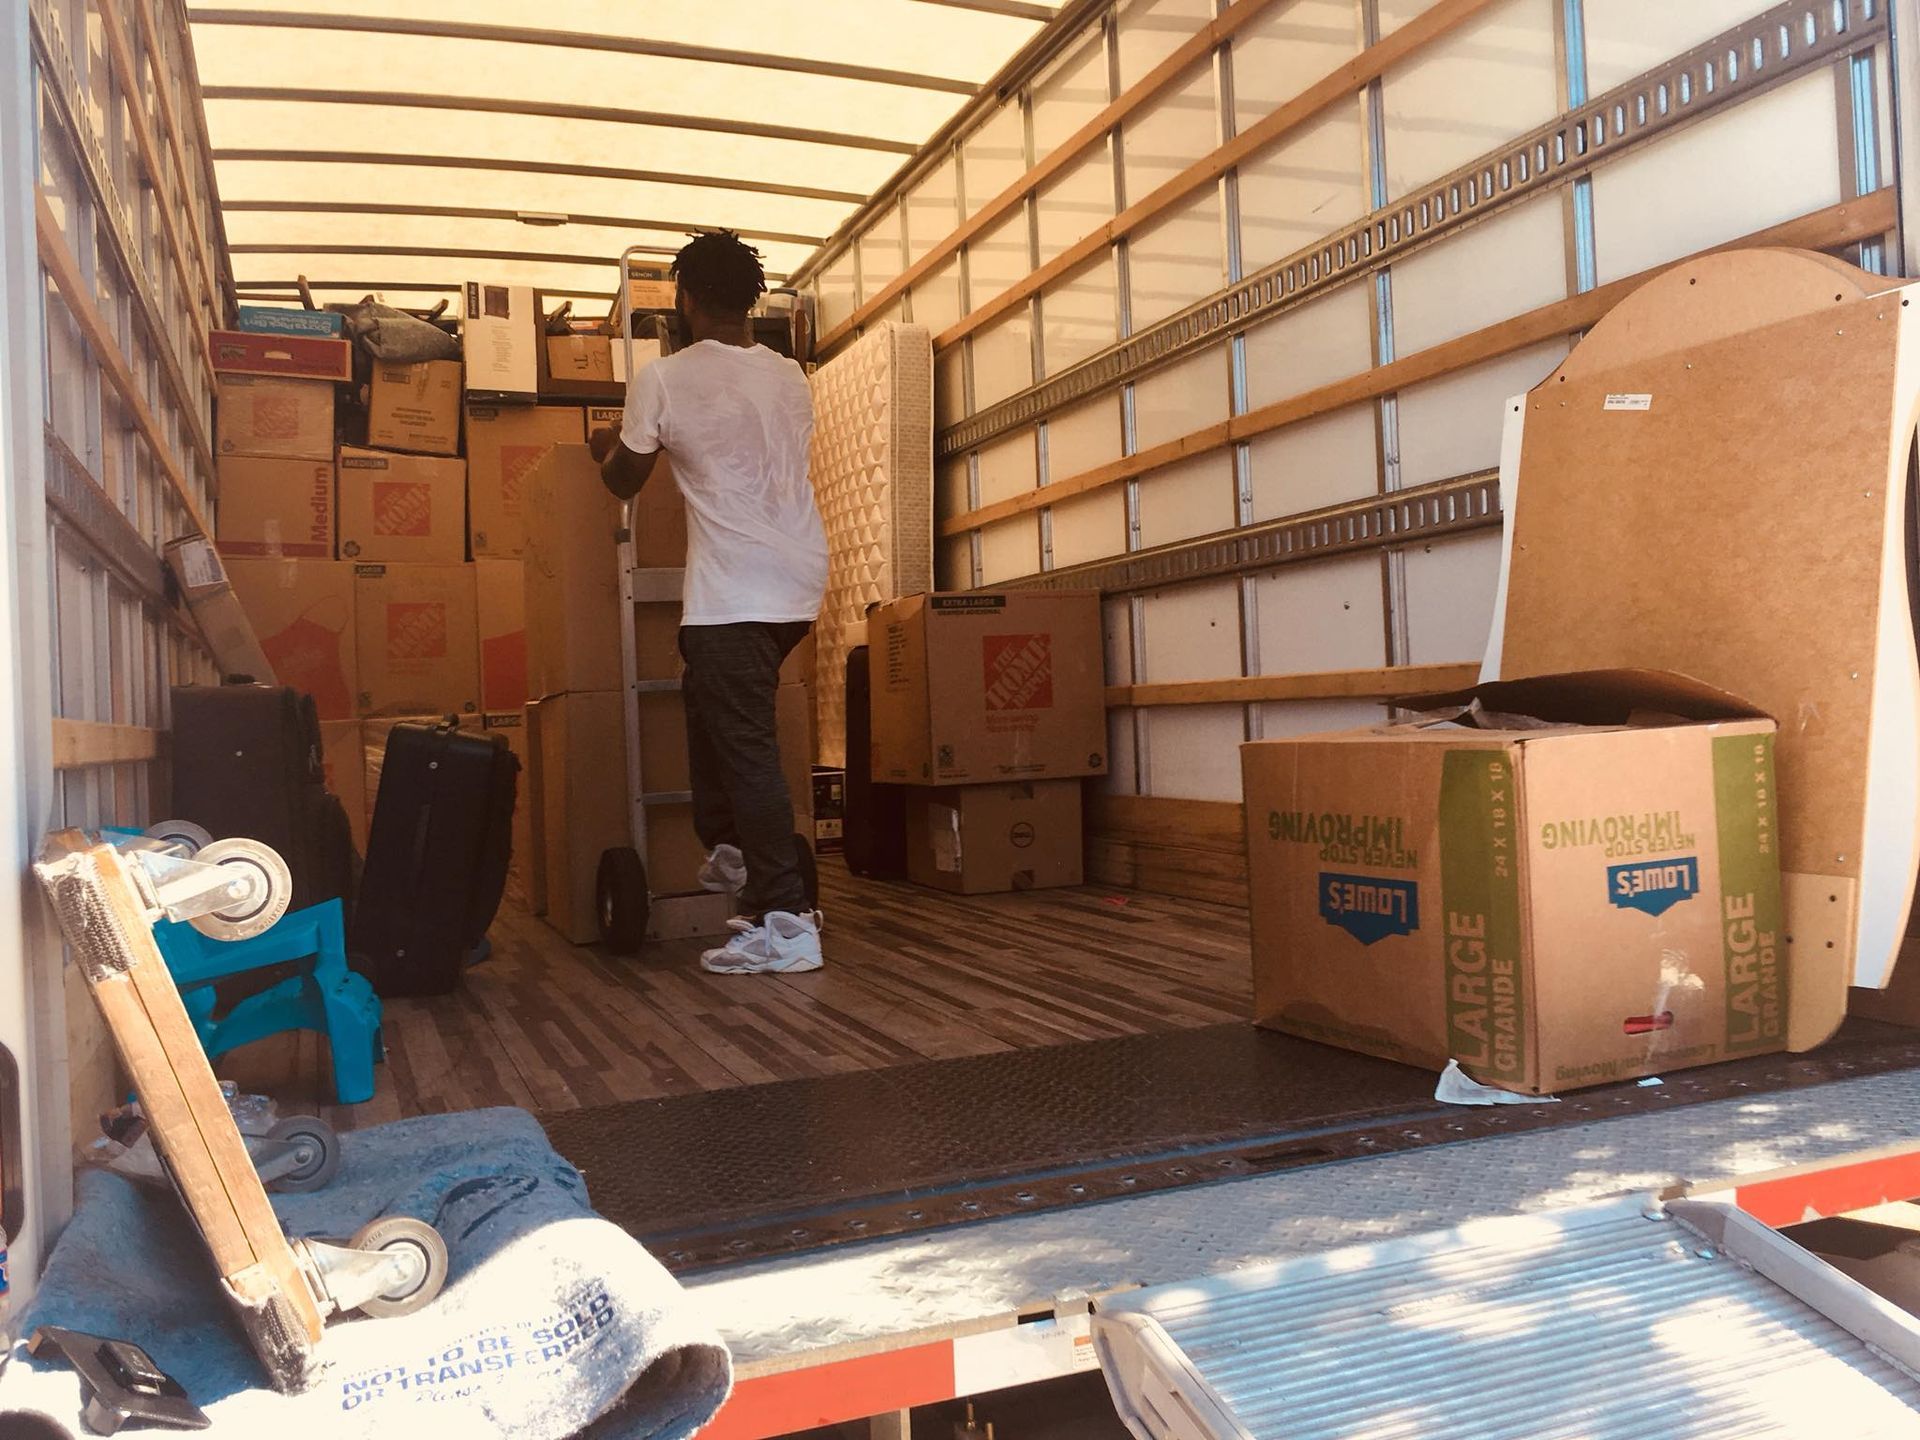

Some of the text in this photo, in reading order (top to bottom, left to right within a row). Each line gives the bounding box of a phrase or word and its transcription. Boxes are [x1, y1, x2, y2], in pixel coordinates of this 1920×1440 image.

[596, 411, 622, 420] LARG
[310, 466, 328, 541] Medium
[984, 638, 1049, 709] HOME
[1491, 789, 1505, 802] X
[1268, 811, 1404, 851] IMPROVING
[1493, 836, 1507, 849] X
[1540, 810, 1681, 849] IMPROVING
[1604, 833, 1695, 858] NEVER STOP
[1320, 844, 1418, 869] NEVER STOP
[1495, 856, 1508, 877] 24
[1616, 864, 1690, 897] LOWE'S
[1328, 881, 1407, 924] LOWE'S
[1726, 893, 1760, 1043] LARGE
[1758, 930, 1780, 1038] GRANDE
[1450, 911, 1489, 1068] LARGE
[1492, 959, 1517, 1072] GRANDE
[342, 1388, 385, 1410] OR
[397, 1306, 614, 1390] TRANSFERRED
[343, 1367, 406, 1394] NOT
[428, 1346, 464, 1367] TO
[477, 1335, 516, 1354] BE
[532, 1293, 609, 1344] SOLD
